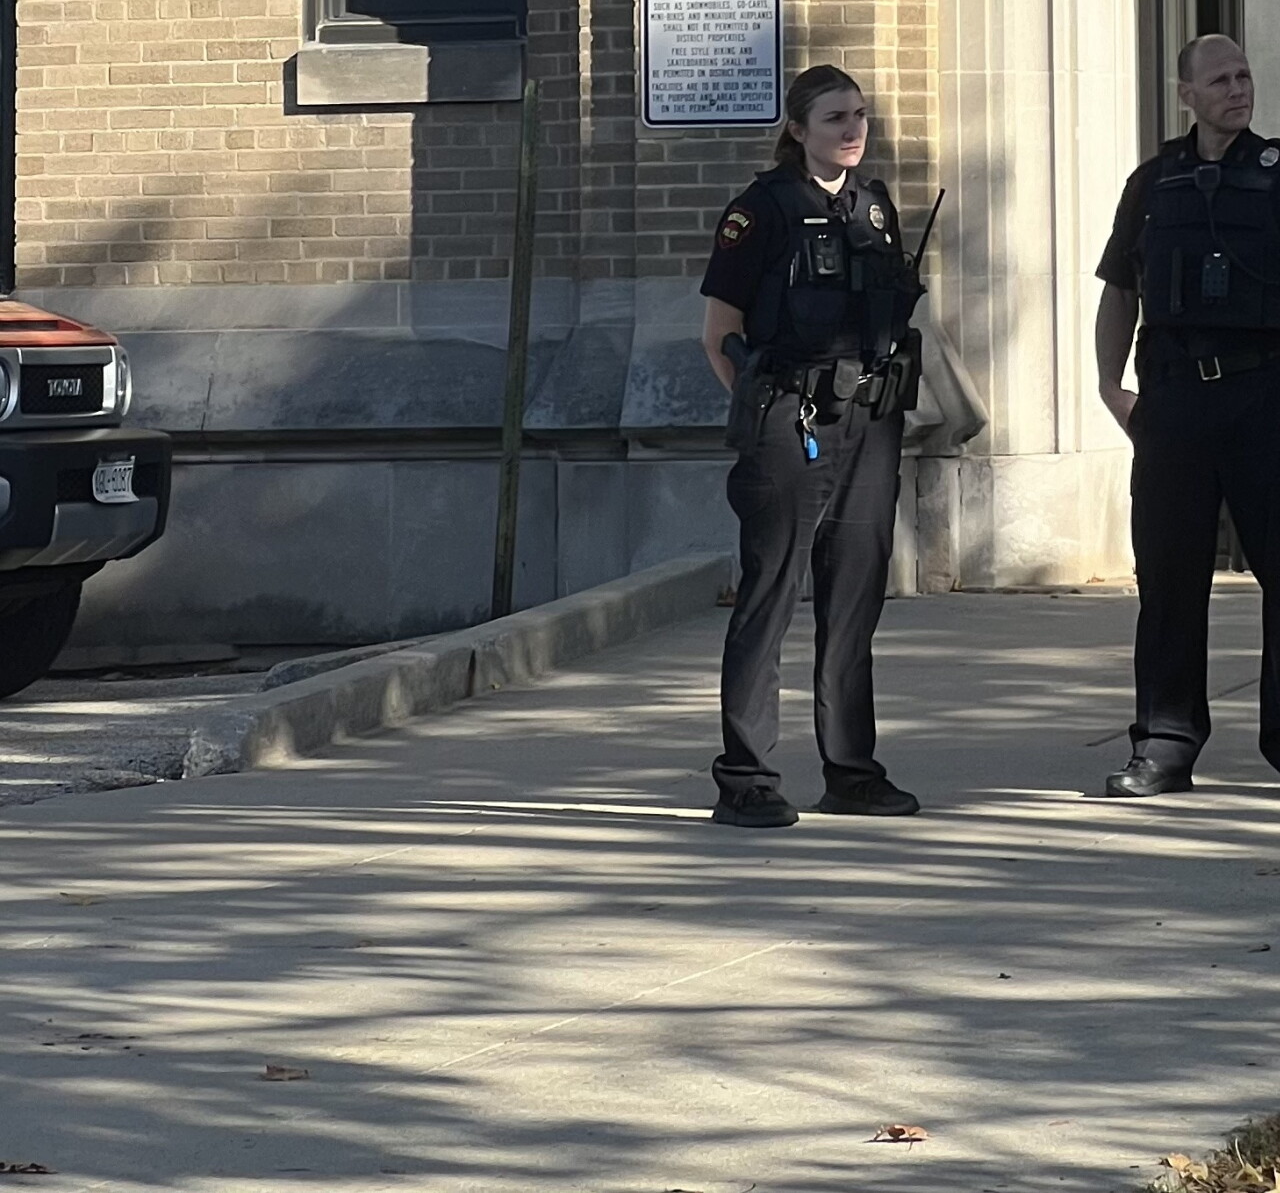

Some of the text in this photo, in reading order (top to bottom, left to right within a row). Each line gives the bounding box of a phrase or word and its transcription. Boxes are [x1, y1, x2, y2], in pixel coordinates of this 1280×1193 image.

[654, 2, 670, 10] SUCH
[674, 2, 682, 10] AS
[688, 12, 700, 21] AND
[704, 11, 736, 20] MINIATURE
[740, 11, 773, 20] AIRPLANES
[663, 22, 761, 32] SHALL NOT BE PERMITTED ON
[676, 34, 704, 43] DISTRICT
[671, 47, 753, 56] FREE STYLE BIKING AND
[667, 57, 757, 67] SKATEBOARDING SHALL NOT
[652, 70, 660, 78] BE
[663, 69, 695, 78] PERMITTED
[697, 69, 706, 78] ON
[709, 69, 734, 77] DISTRICT
[651, 81, 773, 91] FACILITIES ARE TO BE USED ONLY FOR
[652, 92, 773, 102] THE PURPOSE AND AREAS SPECIFIED
[661, 105, 670, 113] ON
[673, 104, 686, 113] THE
[715, 104, 729, 112] AND
